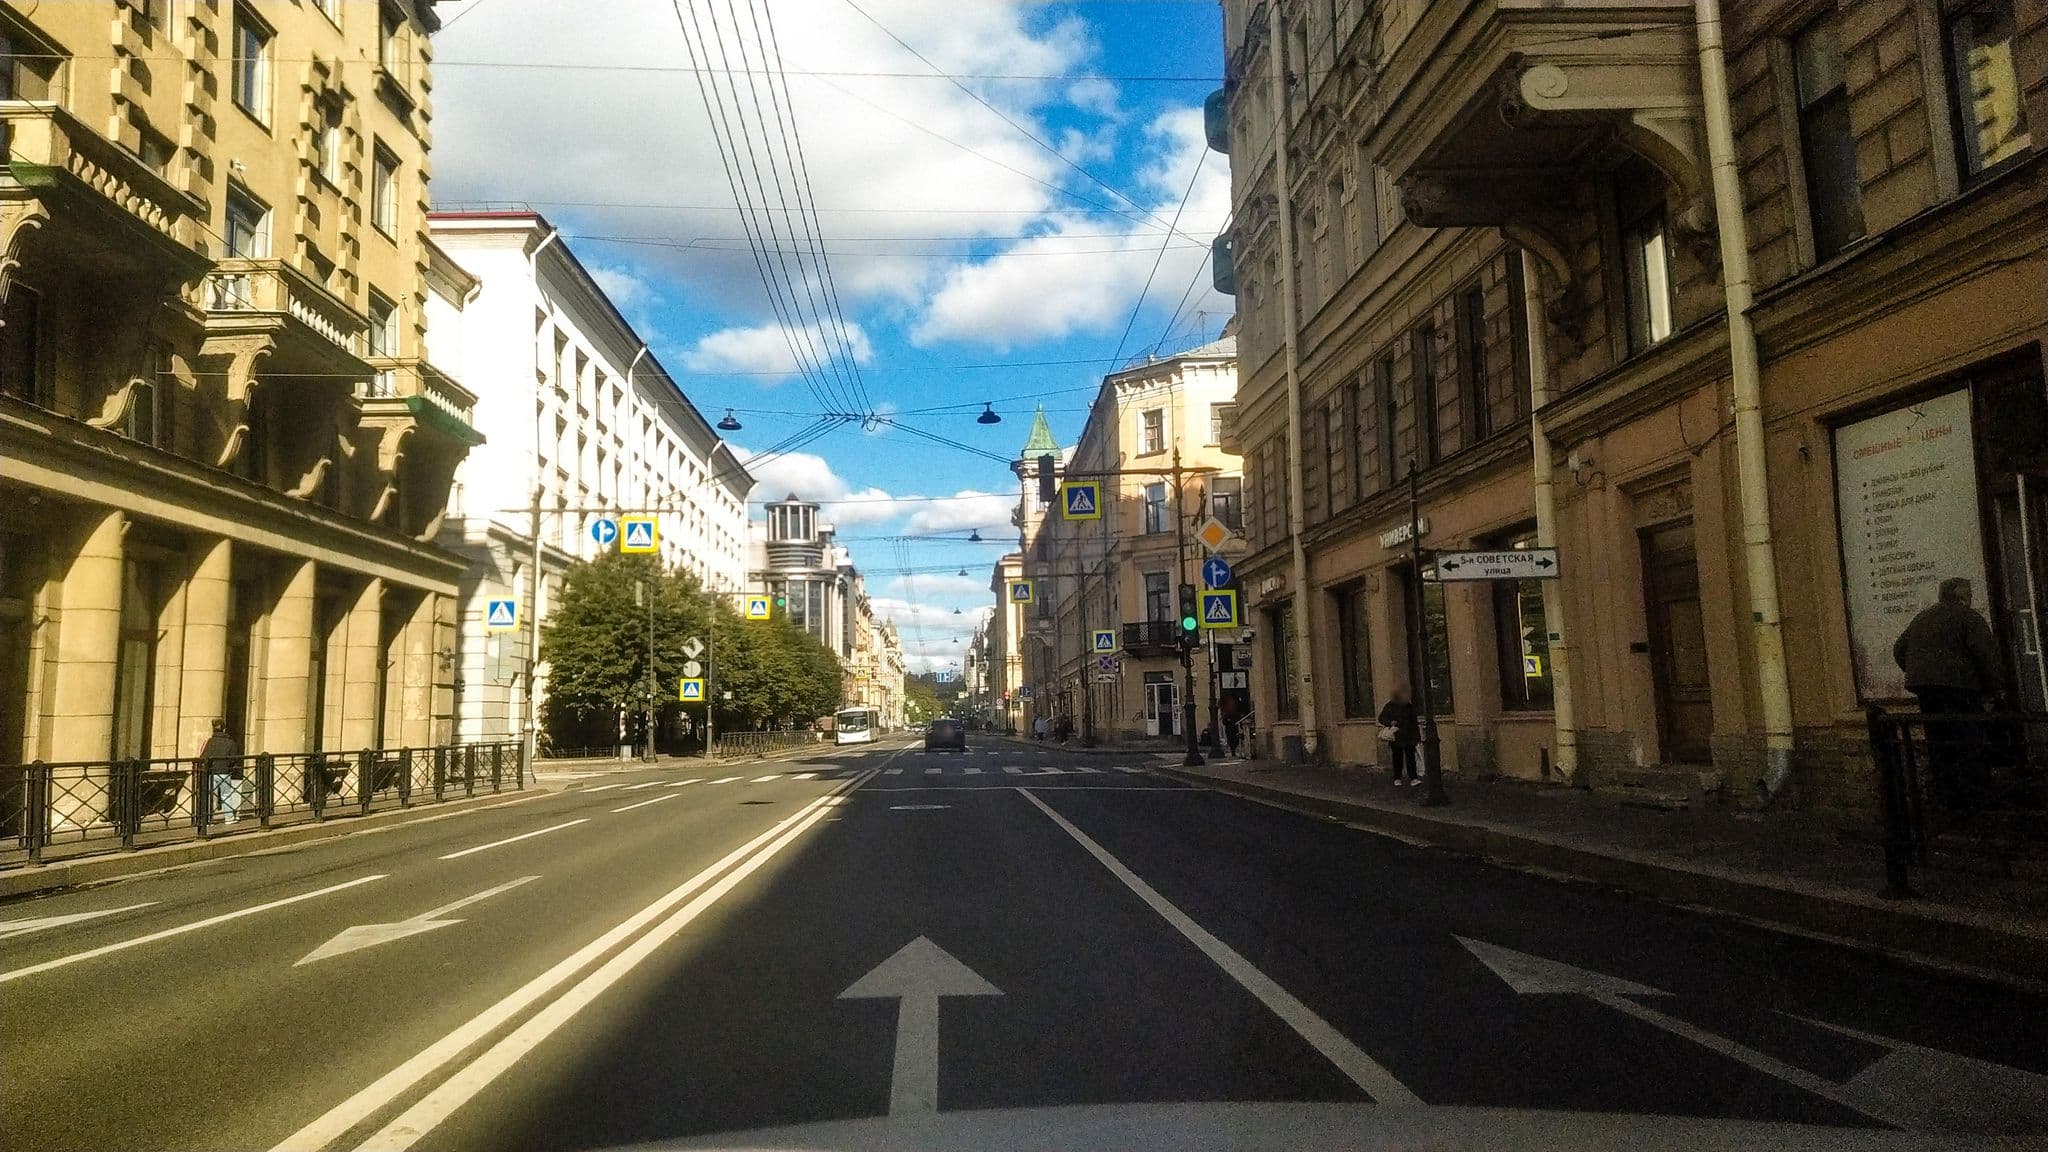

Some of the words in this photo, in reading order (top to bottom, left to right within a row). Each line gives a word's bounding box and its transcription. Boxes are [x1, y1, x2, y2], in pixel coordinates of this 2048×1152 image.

[1853, 437, 1902, 460] СМЕШНЫЕ
[1921, 425, 1952, 442] ЦЕНЫ
[1379, 517, 1424, 549] УНИВЕРСМ
[1476, 554, 1534, 564] СОВЕТСКАЯ
[1484, 567, 1511, 577] улица
